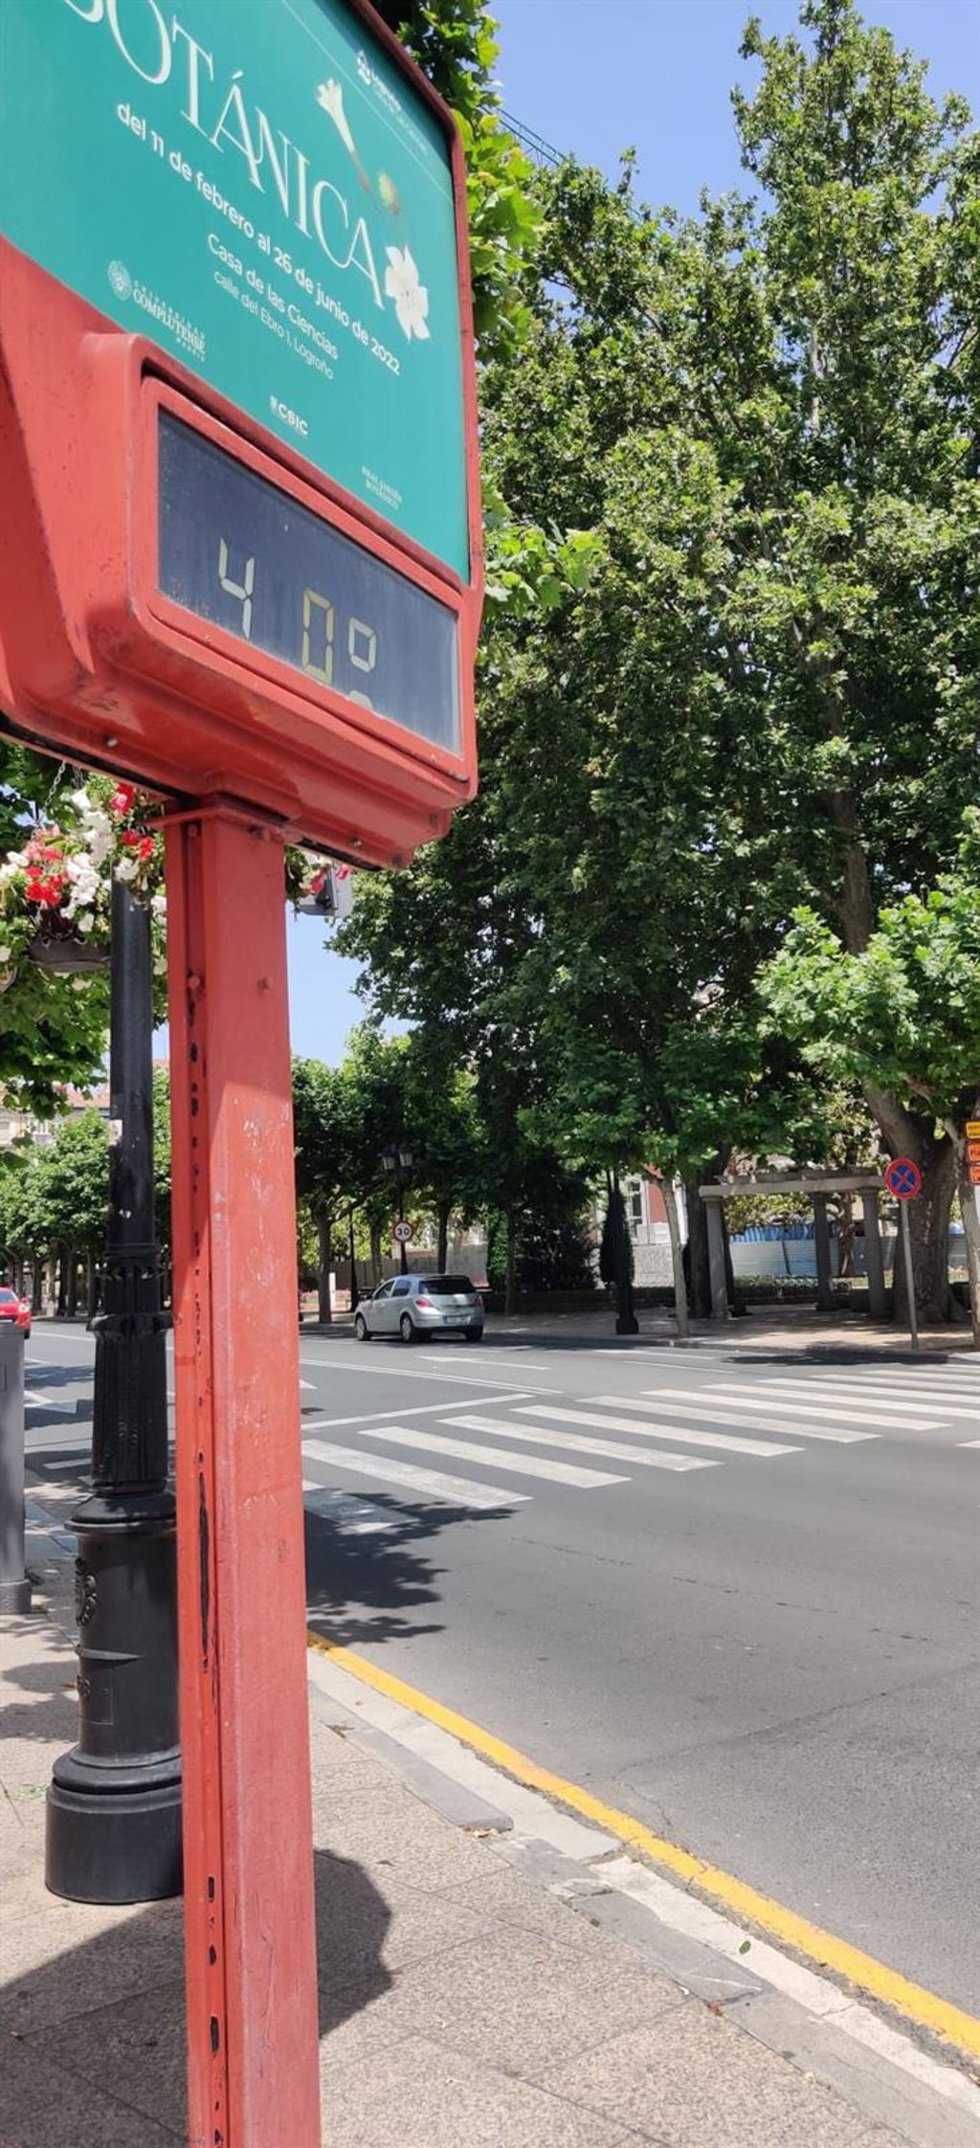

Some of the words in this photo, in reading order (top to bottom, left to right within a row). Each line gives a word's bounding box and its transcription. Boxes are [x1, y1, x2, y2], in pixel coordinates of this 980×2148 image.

[64, 0, 385, 311] OTÁNICA
[116, 103, 147, 140] del
[150, 130, 165, 157] 11
[169, 151, 193, 183] de
[196, 172, 254, 238] febrero
[257, 232, 271, 255] al
[273, 246, 293, 275] 26
[294, 267, 314, 295] de
[315, 282, 350, 328] junio
[351, 319, 369, 346] de
[370, 337, 400, 377] 2022
[208, 234, 242, 276] Casa
[245, 268, 265, 295] de
[267, 283, 286, 314] las
[288, 304, 338, 360] Ciencias
[213, 270, 240, 300] calle
[241, 293, 259, 318] del
[260, 306, 285, 339] Ebro
[278, 402, 309, 436] CSIC
